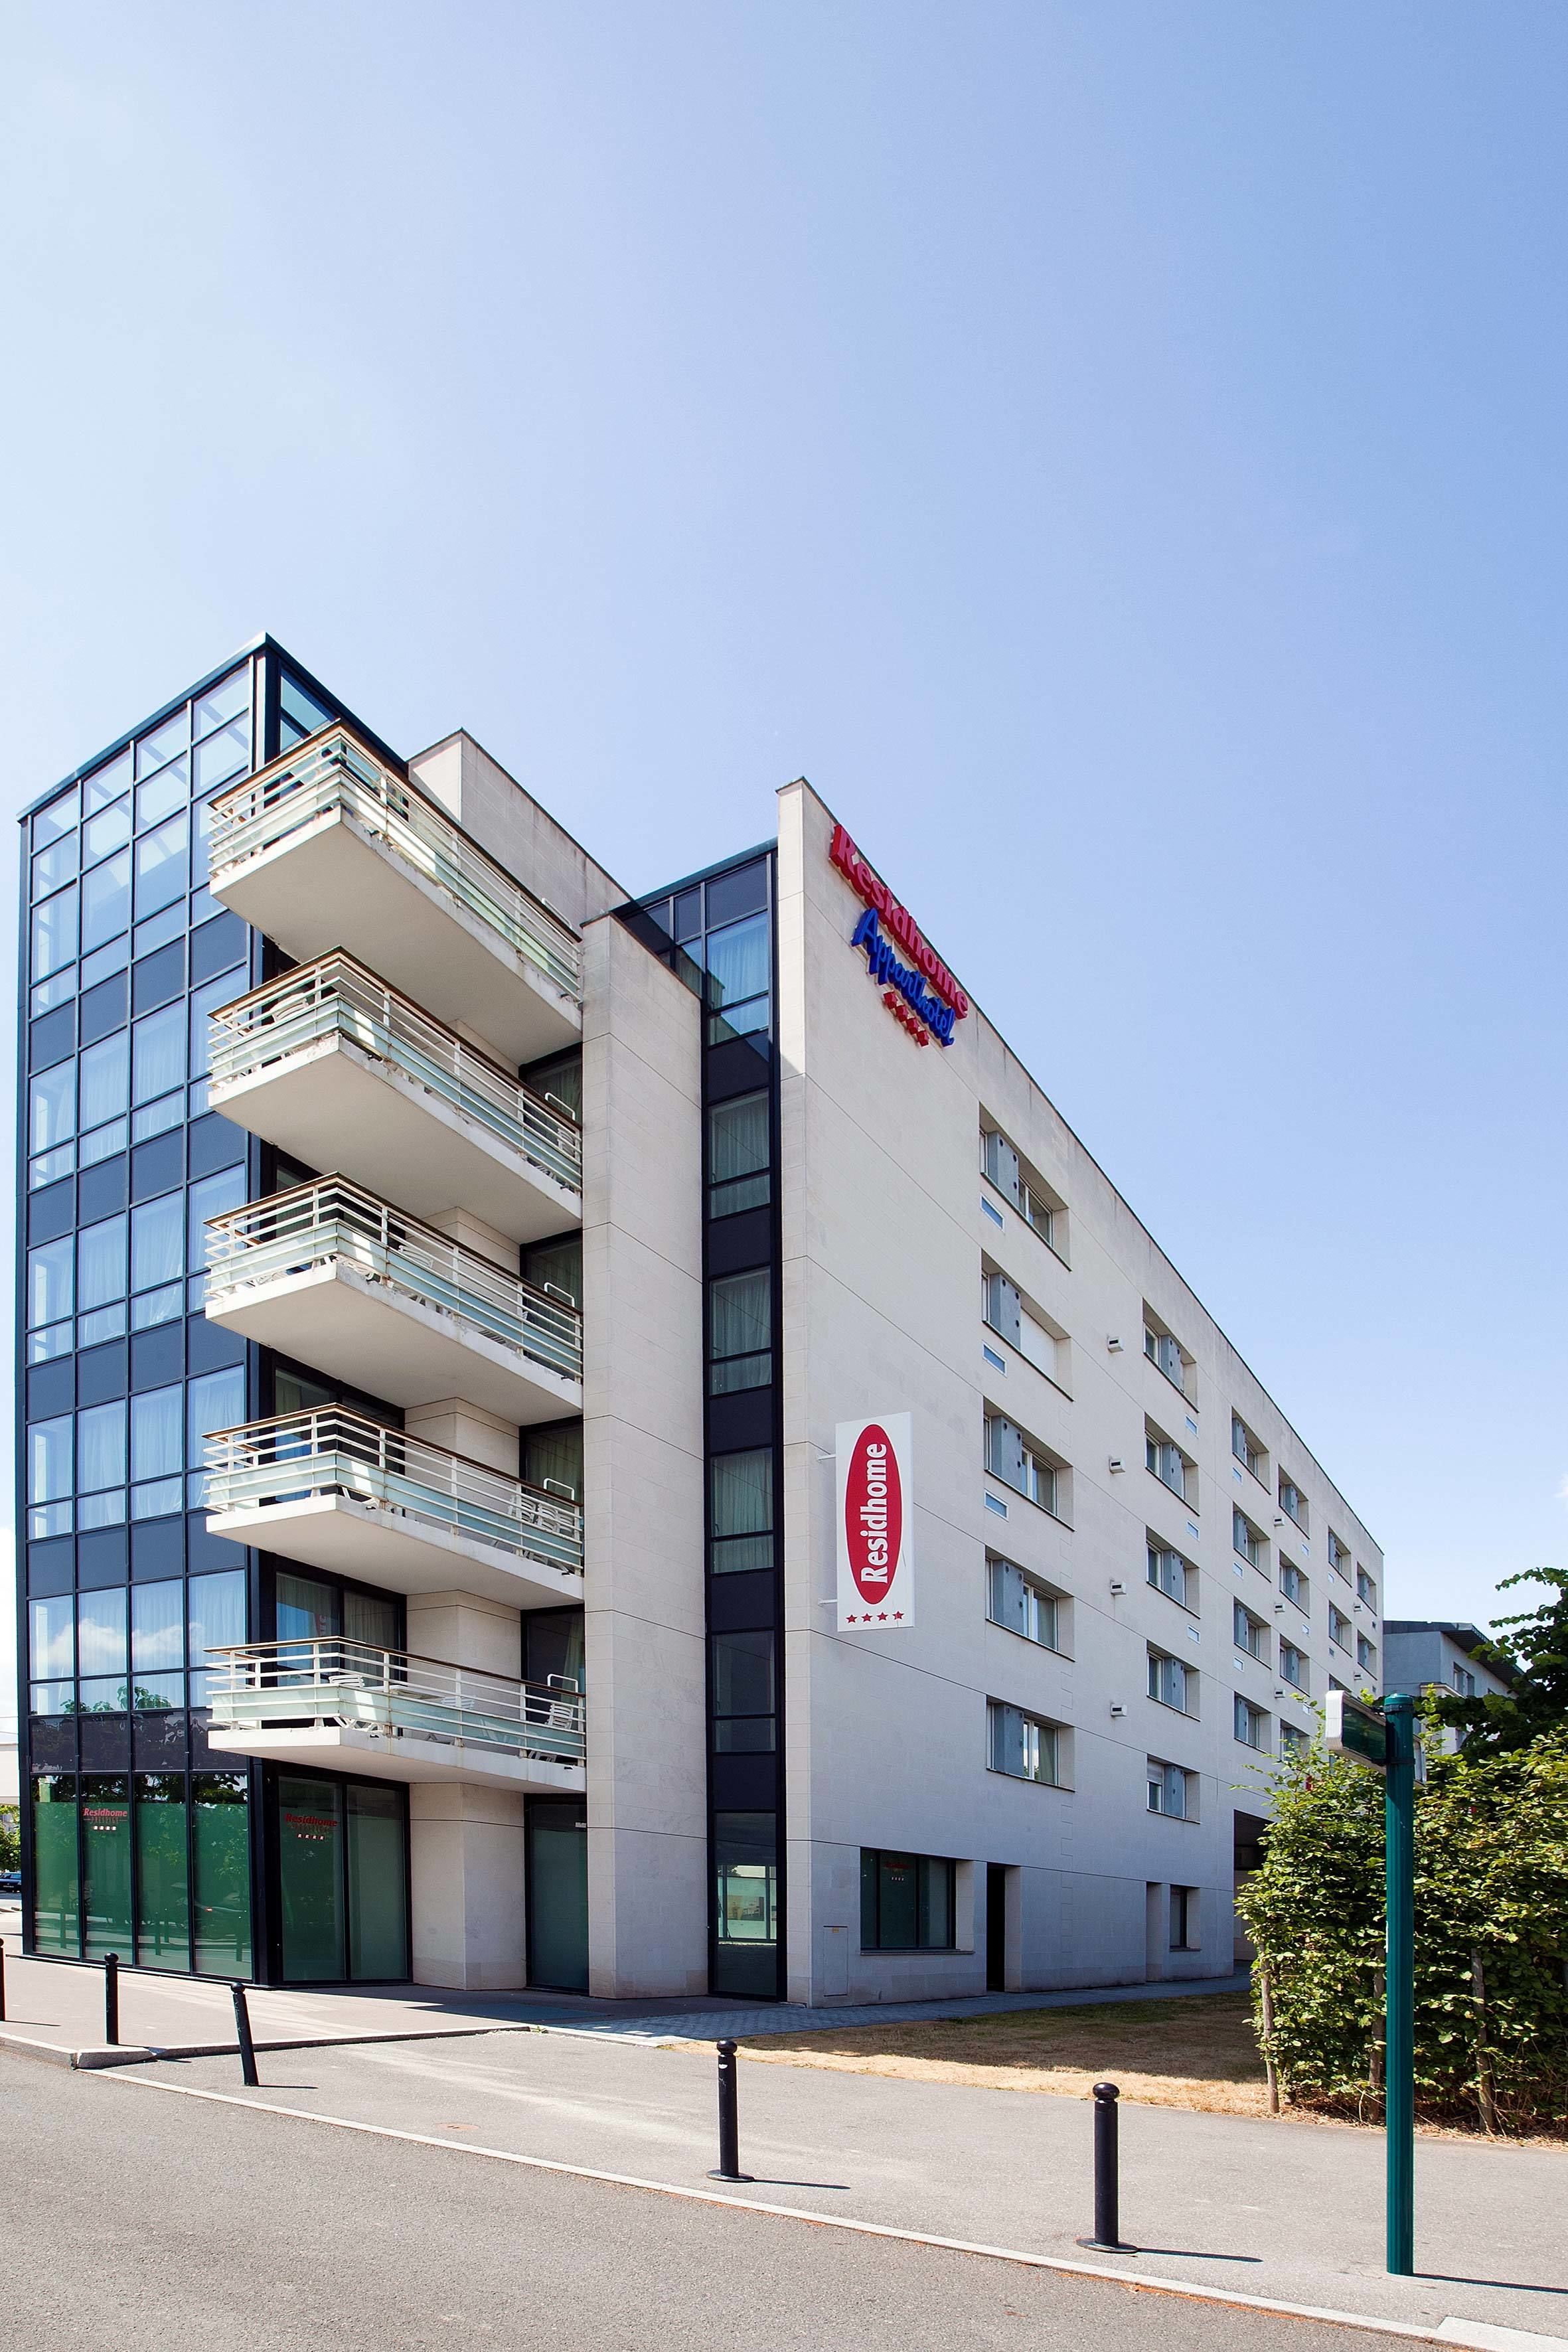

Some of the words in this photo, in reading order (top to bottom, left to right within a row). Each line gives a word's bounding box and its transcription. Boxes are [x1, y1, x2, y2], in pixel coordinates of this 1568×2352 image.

[829, 824, 969, 1020] Residhome
[860, 1443, 888, 1584] Residhome
[84, 1808, 128, 1817] Residhome
[285, 1813, 338, 1826] Residhome
